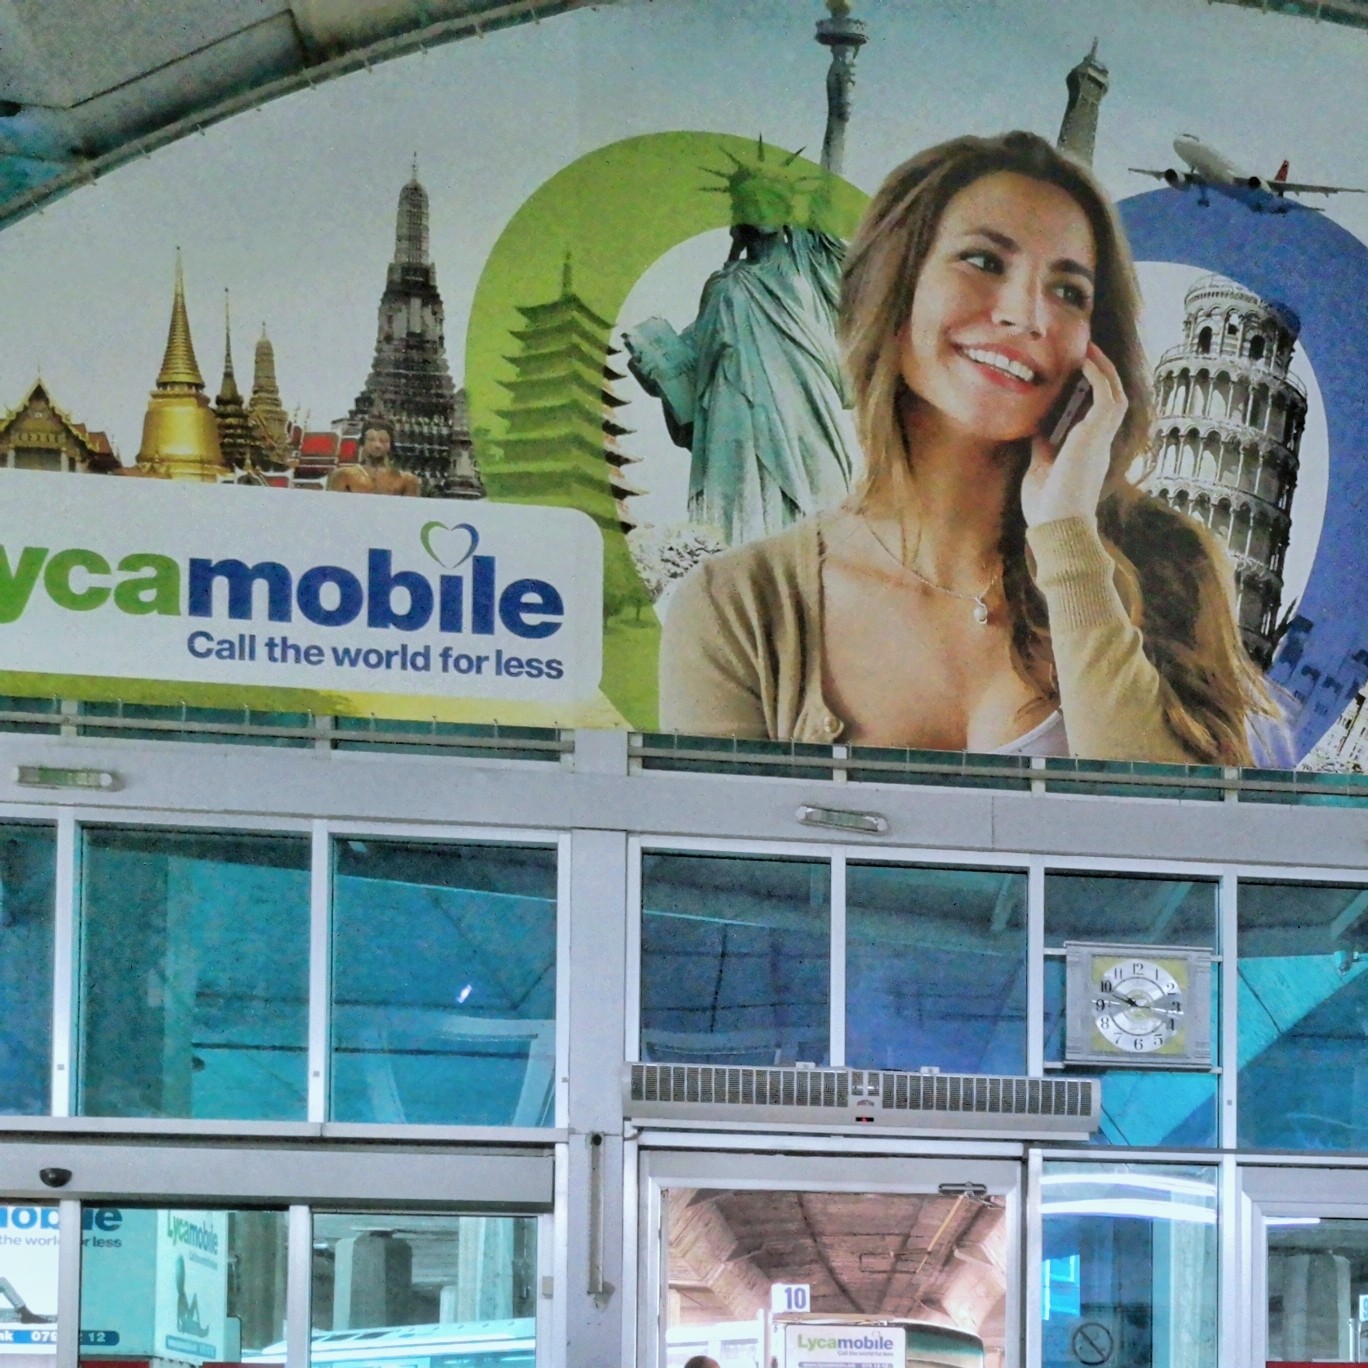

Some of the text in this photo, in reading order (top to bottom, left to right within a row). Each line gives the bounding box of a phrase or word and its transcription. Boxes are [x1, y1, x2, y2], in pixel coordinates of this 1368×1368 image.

[187, 629, 564, 681] Call the world for less
[1132, 963, 1145, 976] 12
[1101, 980, 1113, 993] 10
[1096, 999, 1105, 1012] 9
[1101, 1017, 1109, 1029] 8
[1113, 1032, 1123, 1045] 7
[1134, 1038, 1143, 1051] 6
[1154, 1034, 1163, 1045] 5
[784, 1287, 807, 1309] 10
[88, 1331, 106, 1343] 12
[797, 1334, 894, 1351] Lycamobile
